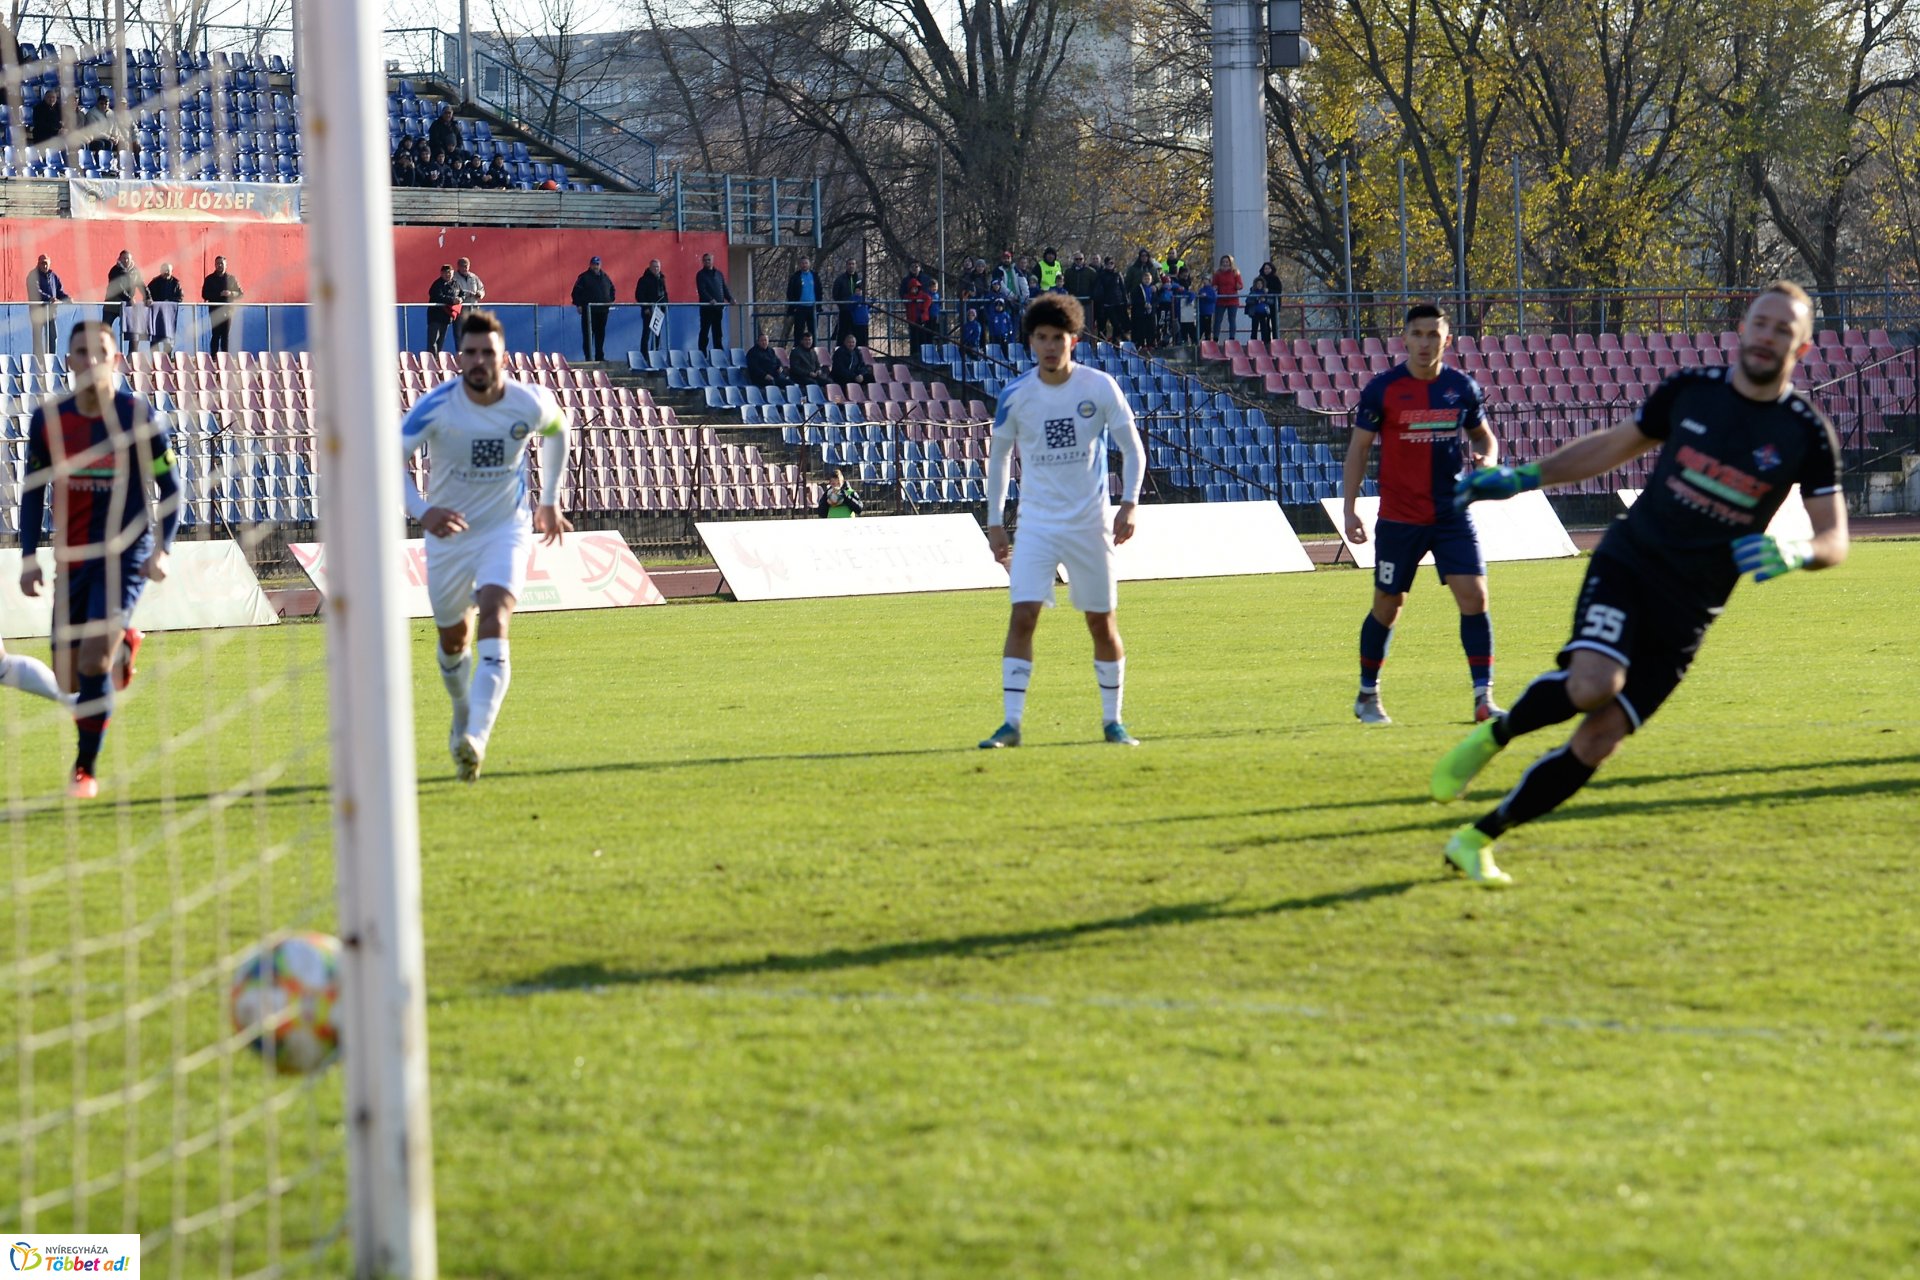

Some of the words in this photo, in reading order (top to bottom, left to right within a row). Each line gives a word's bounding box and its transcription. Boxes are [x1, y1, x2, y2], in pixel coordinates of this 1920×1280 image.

[117, 189, 185, 210] BOZSIK
[189, 188, 256, 210] JÓZSEF
[1379, 560, 1395, 585] 18
[1581, 604, 1627, 643] 55
